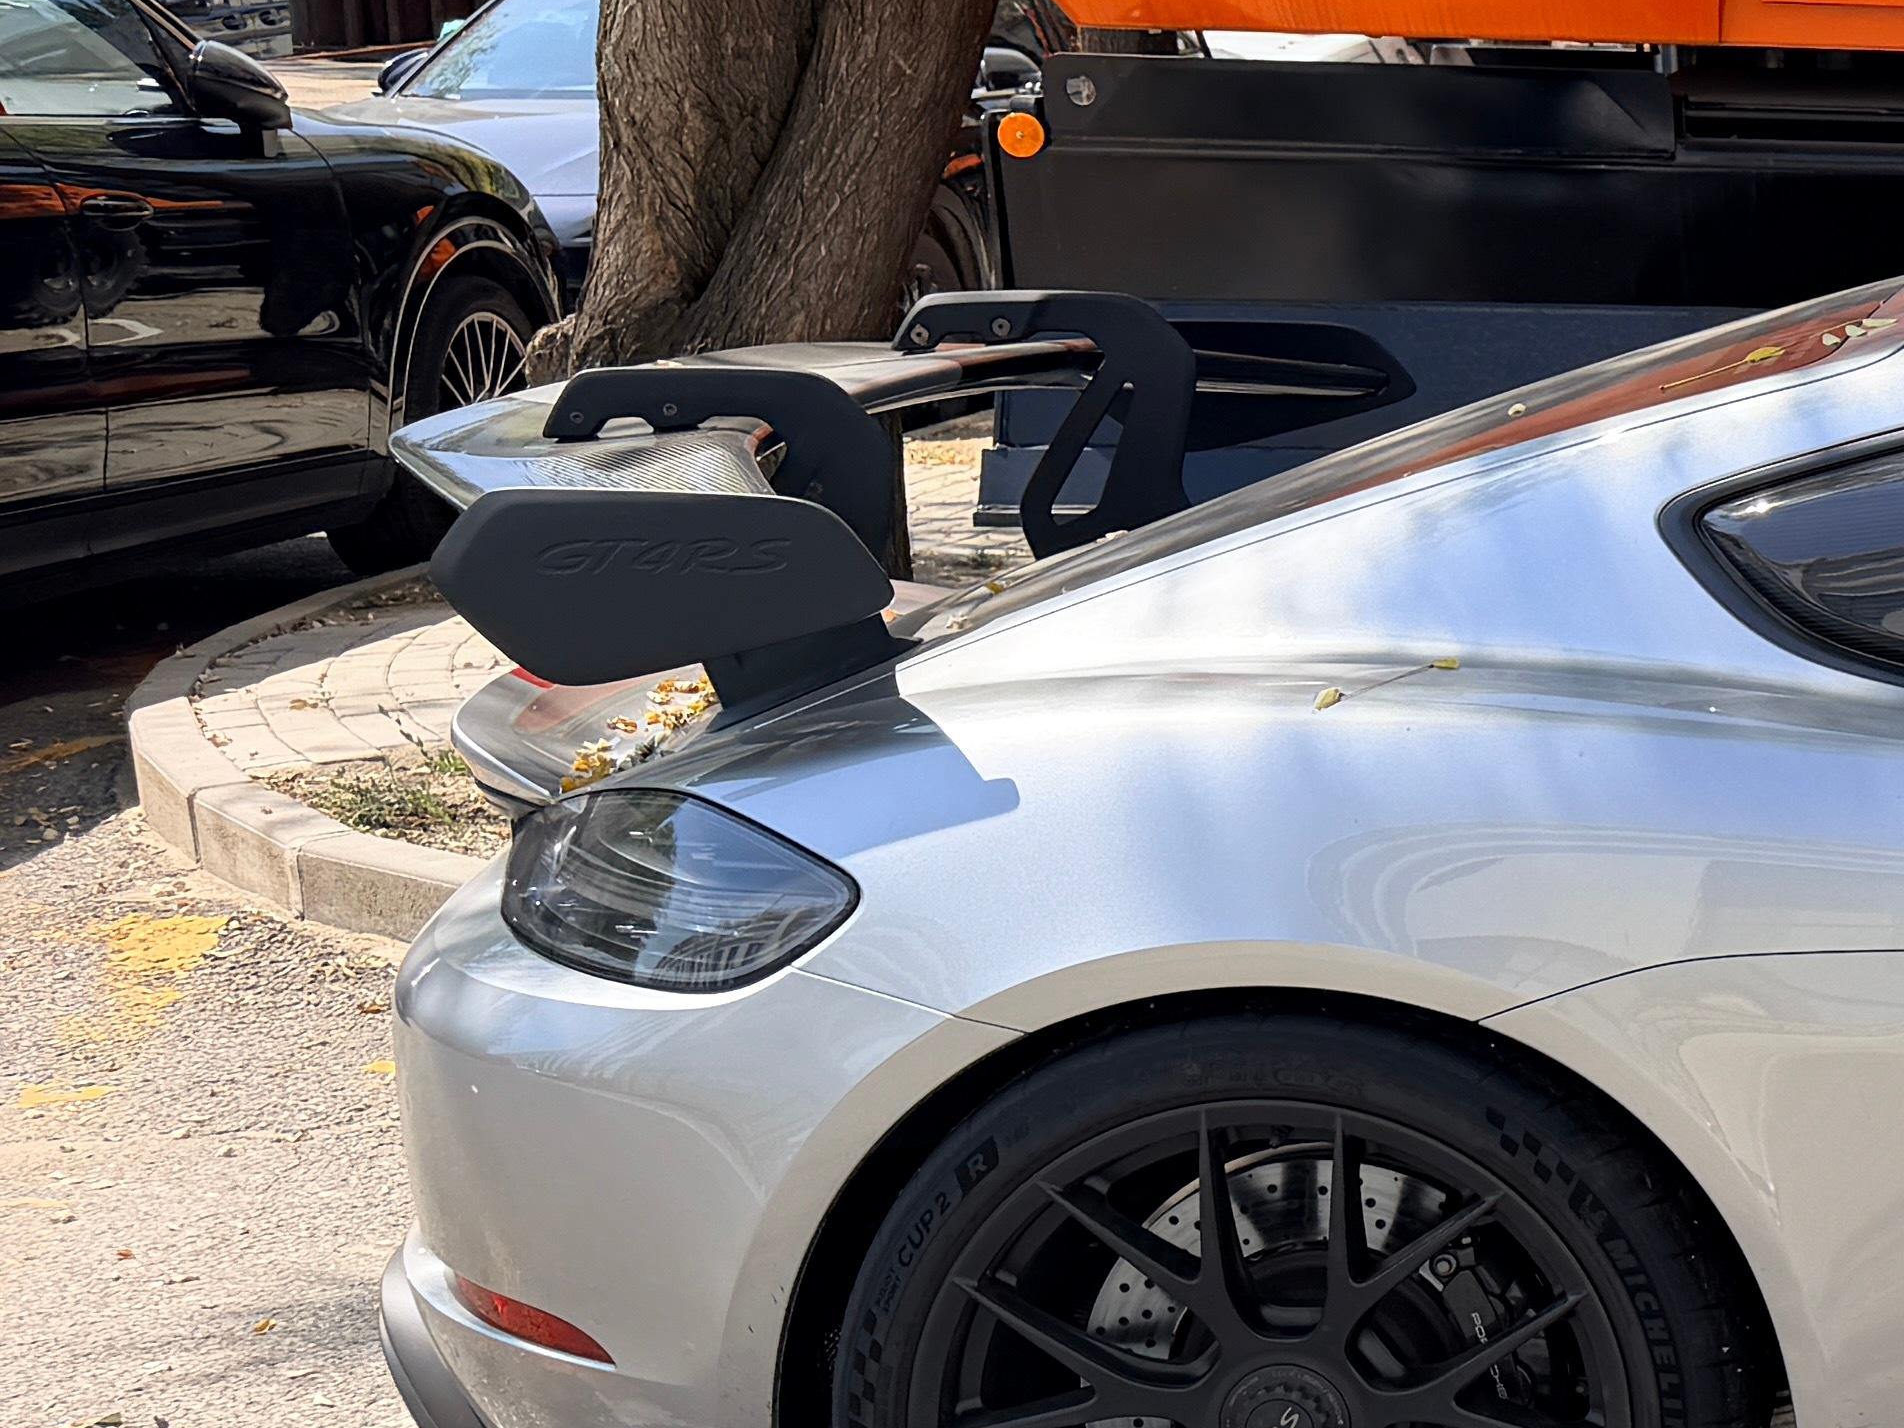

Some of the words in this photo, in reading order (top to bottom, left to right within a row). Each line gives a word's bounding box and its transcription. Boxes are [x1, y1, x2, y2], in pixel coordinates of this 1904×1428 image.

[537, 535, 794, 574] GT4RS
[897, 1208, 935, 1269] CUP
[932, 1190, 952, 1215] 2
[966, 1152, 990, 1182] R
